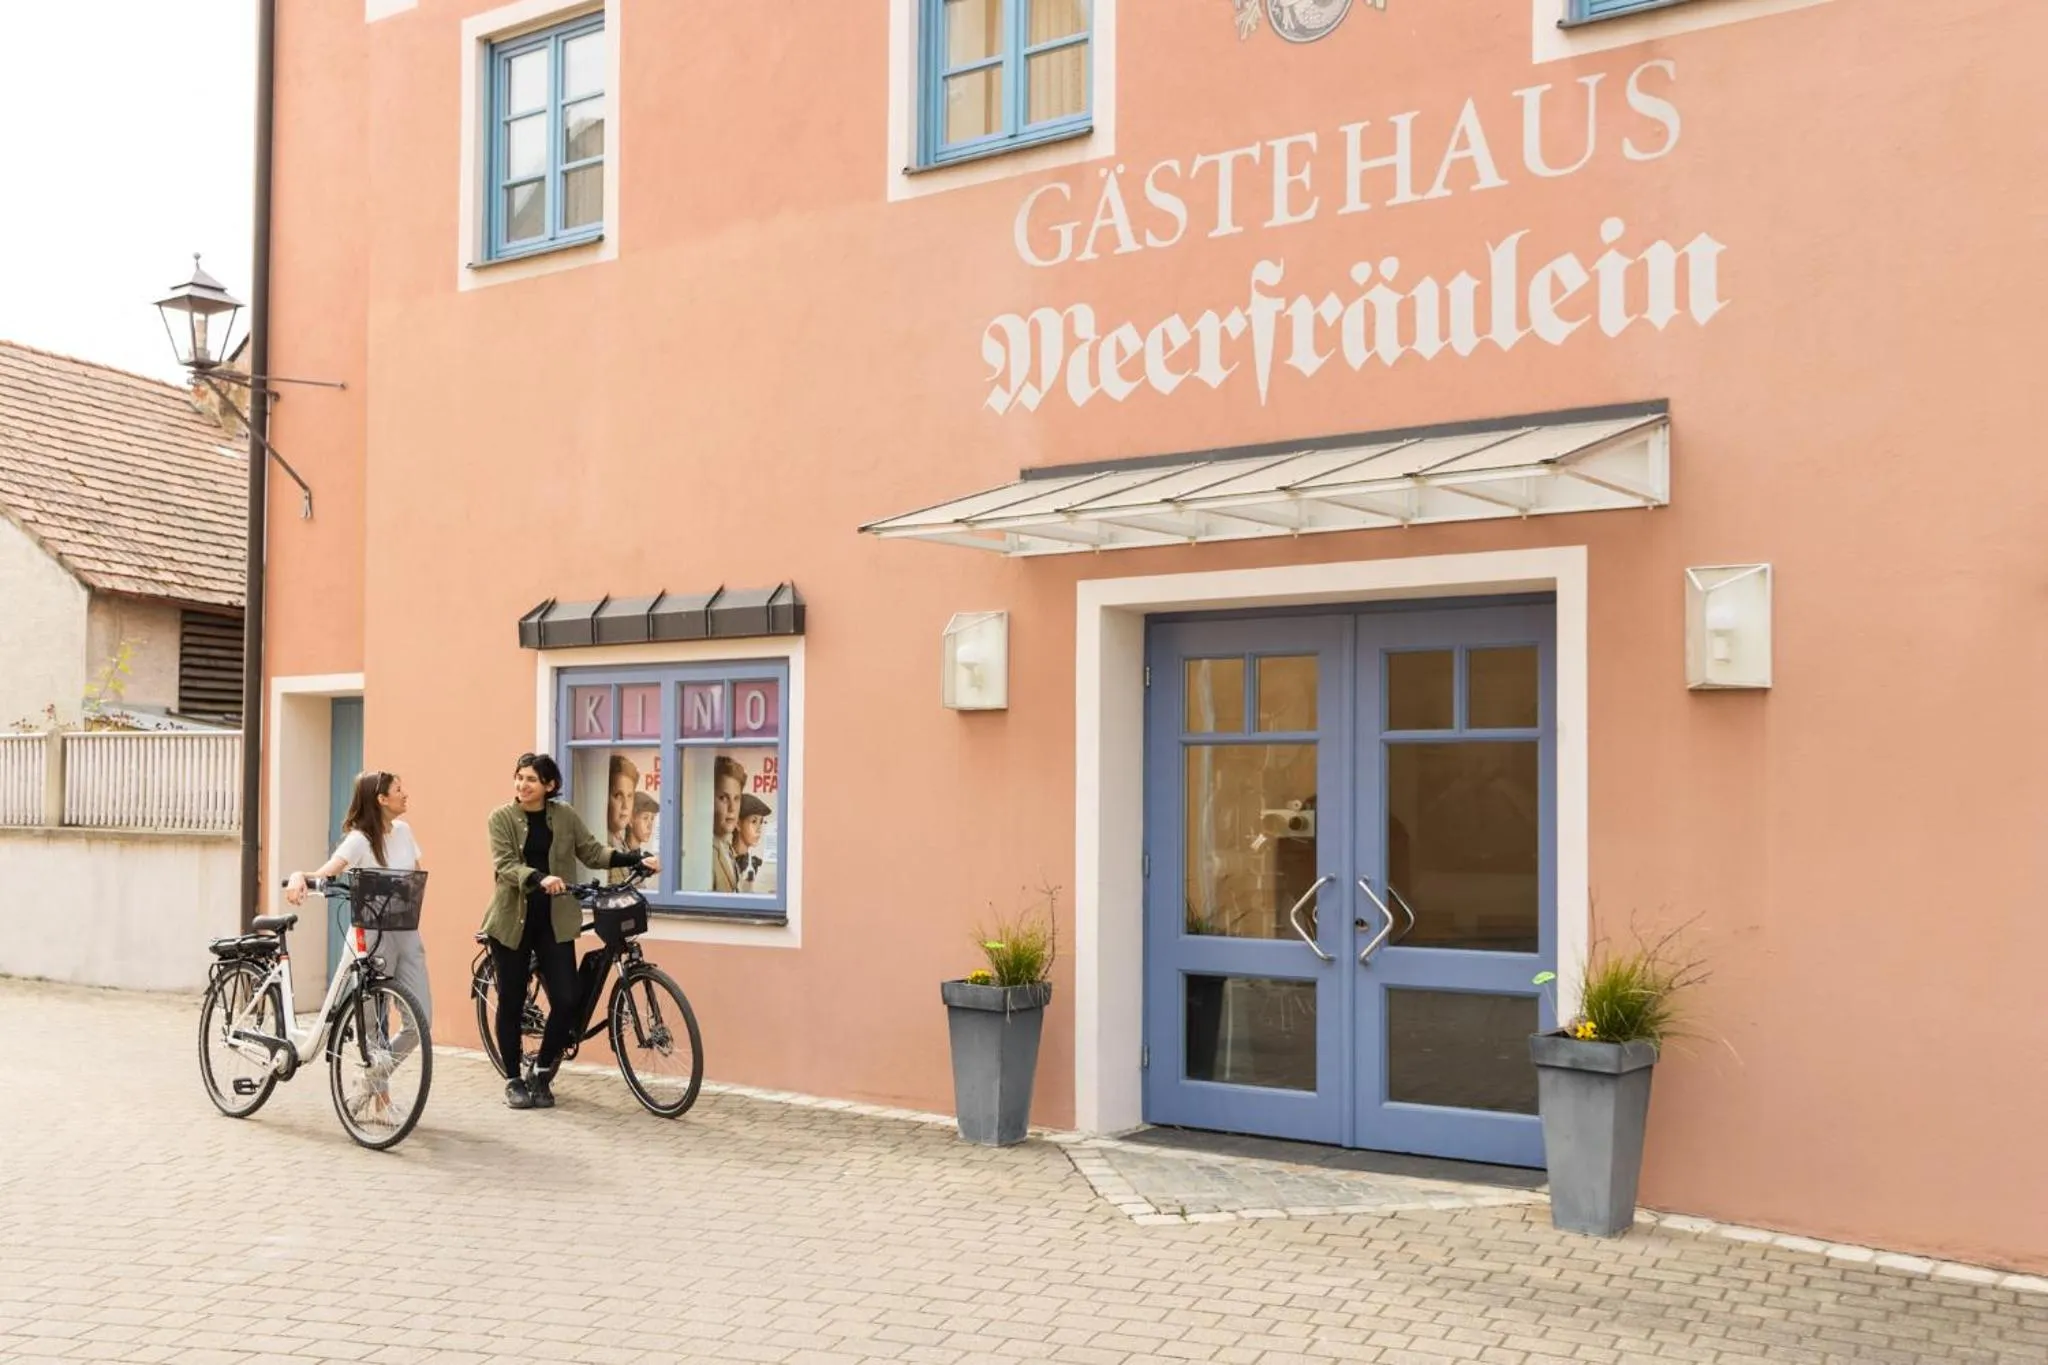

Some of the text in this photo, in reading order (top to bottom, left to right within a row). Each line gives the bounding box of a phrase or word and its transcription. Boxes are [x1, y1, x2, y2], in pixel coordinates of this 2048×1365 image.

[1013, 58, 1682, 268] GÄSTEHAUS
[981, 216, 1732, 416] Meerfräulein
[585, 689, 766, 733] KINO
